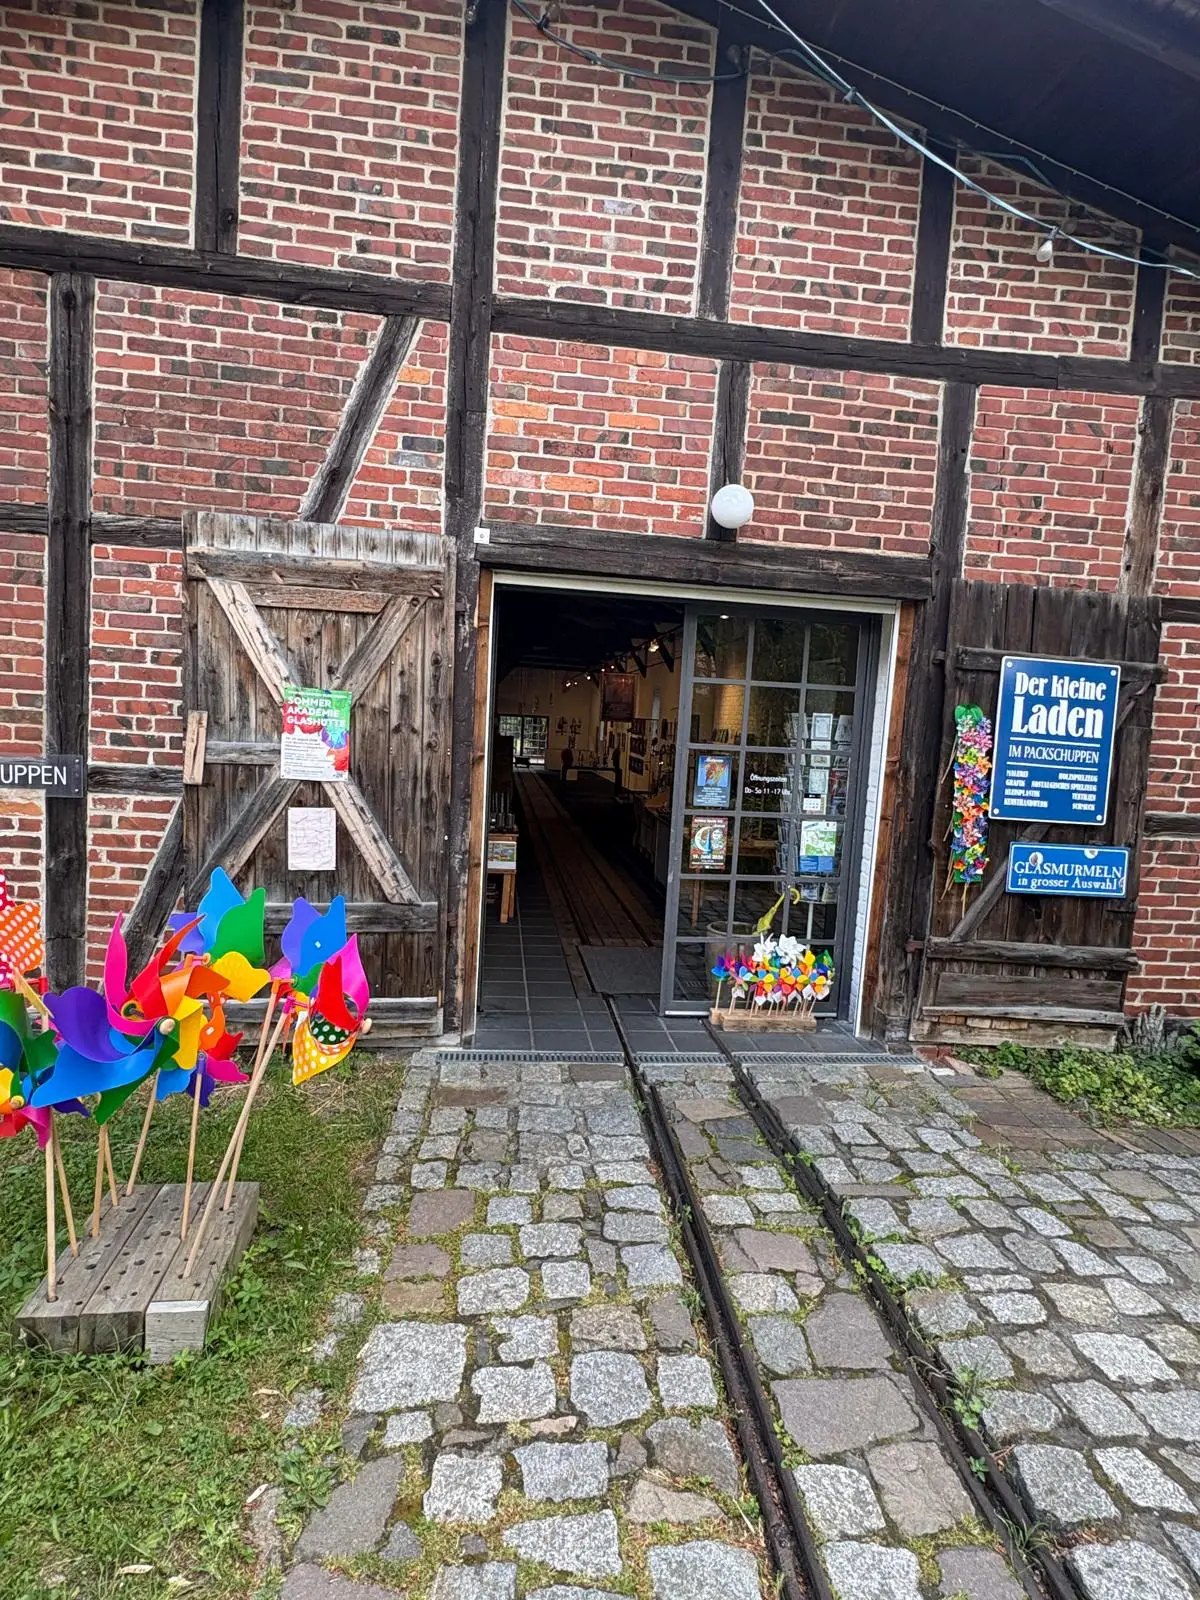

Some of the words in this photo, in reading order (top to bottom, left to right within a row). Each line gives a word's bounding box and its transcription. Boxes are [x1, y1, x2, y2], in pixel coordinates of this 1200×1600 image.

[1014, 671, 1048, 696] Der
[1051, 674, 1107, 701] kleine
[288, 696, 332, 708] SOMMER
[287, 706, 340, 718] AKADEMIE
[1011, 696, 1104, 739] Laden
[1008, 744, 1022, 758] IM
[1023, 746, 1100, 764] PACKSCHUPPEN
[0, 764, 67, 785] UPPEN
[1014, 861, 1123, 878] GLASMURMELN
[1017, 874, 1028, 886] in
[1030, 877, 1069, 890] grosser
[1072, 876, 1117, 890] Auswahl
